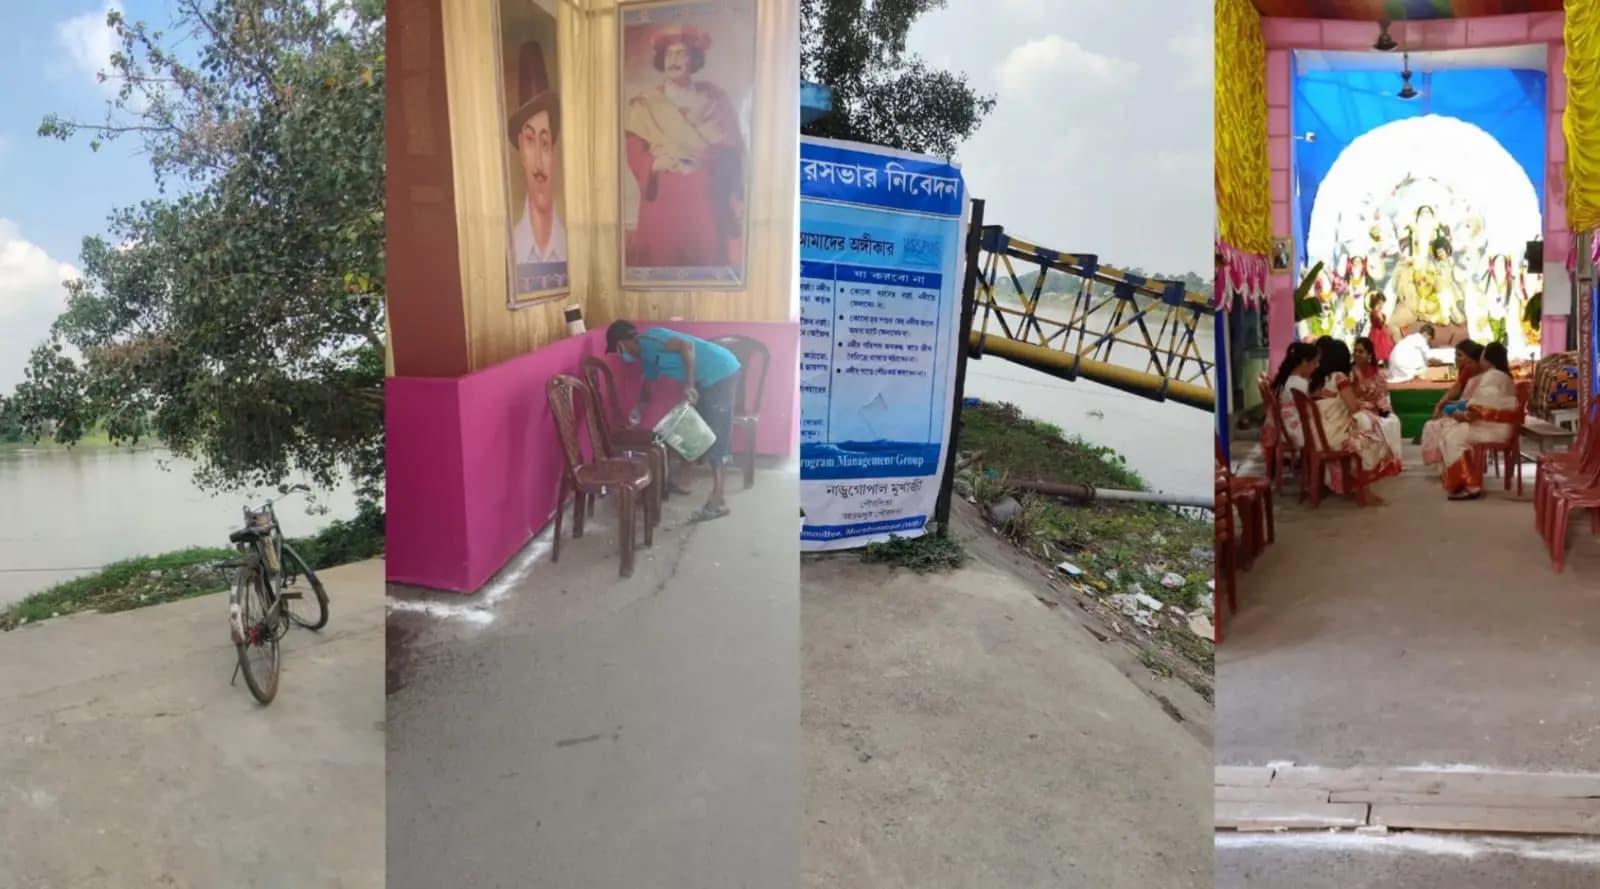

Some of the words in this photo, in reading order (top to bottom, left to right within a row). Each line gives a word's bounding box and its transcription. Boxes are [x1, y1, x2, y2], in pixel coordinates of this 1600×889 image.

[800, 159, 878, 188] রসভার
[884, 162, 960, 199] নিবেদন
[849, 233, 894, 256] অঙ্গীকার
[800, 458, 835, 470] rogram
[838, 454, 894, 468] Management
[896, 453, 924, 468] Group
